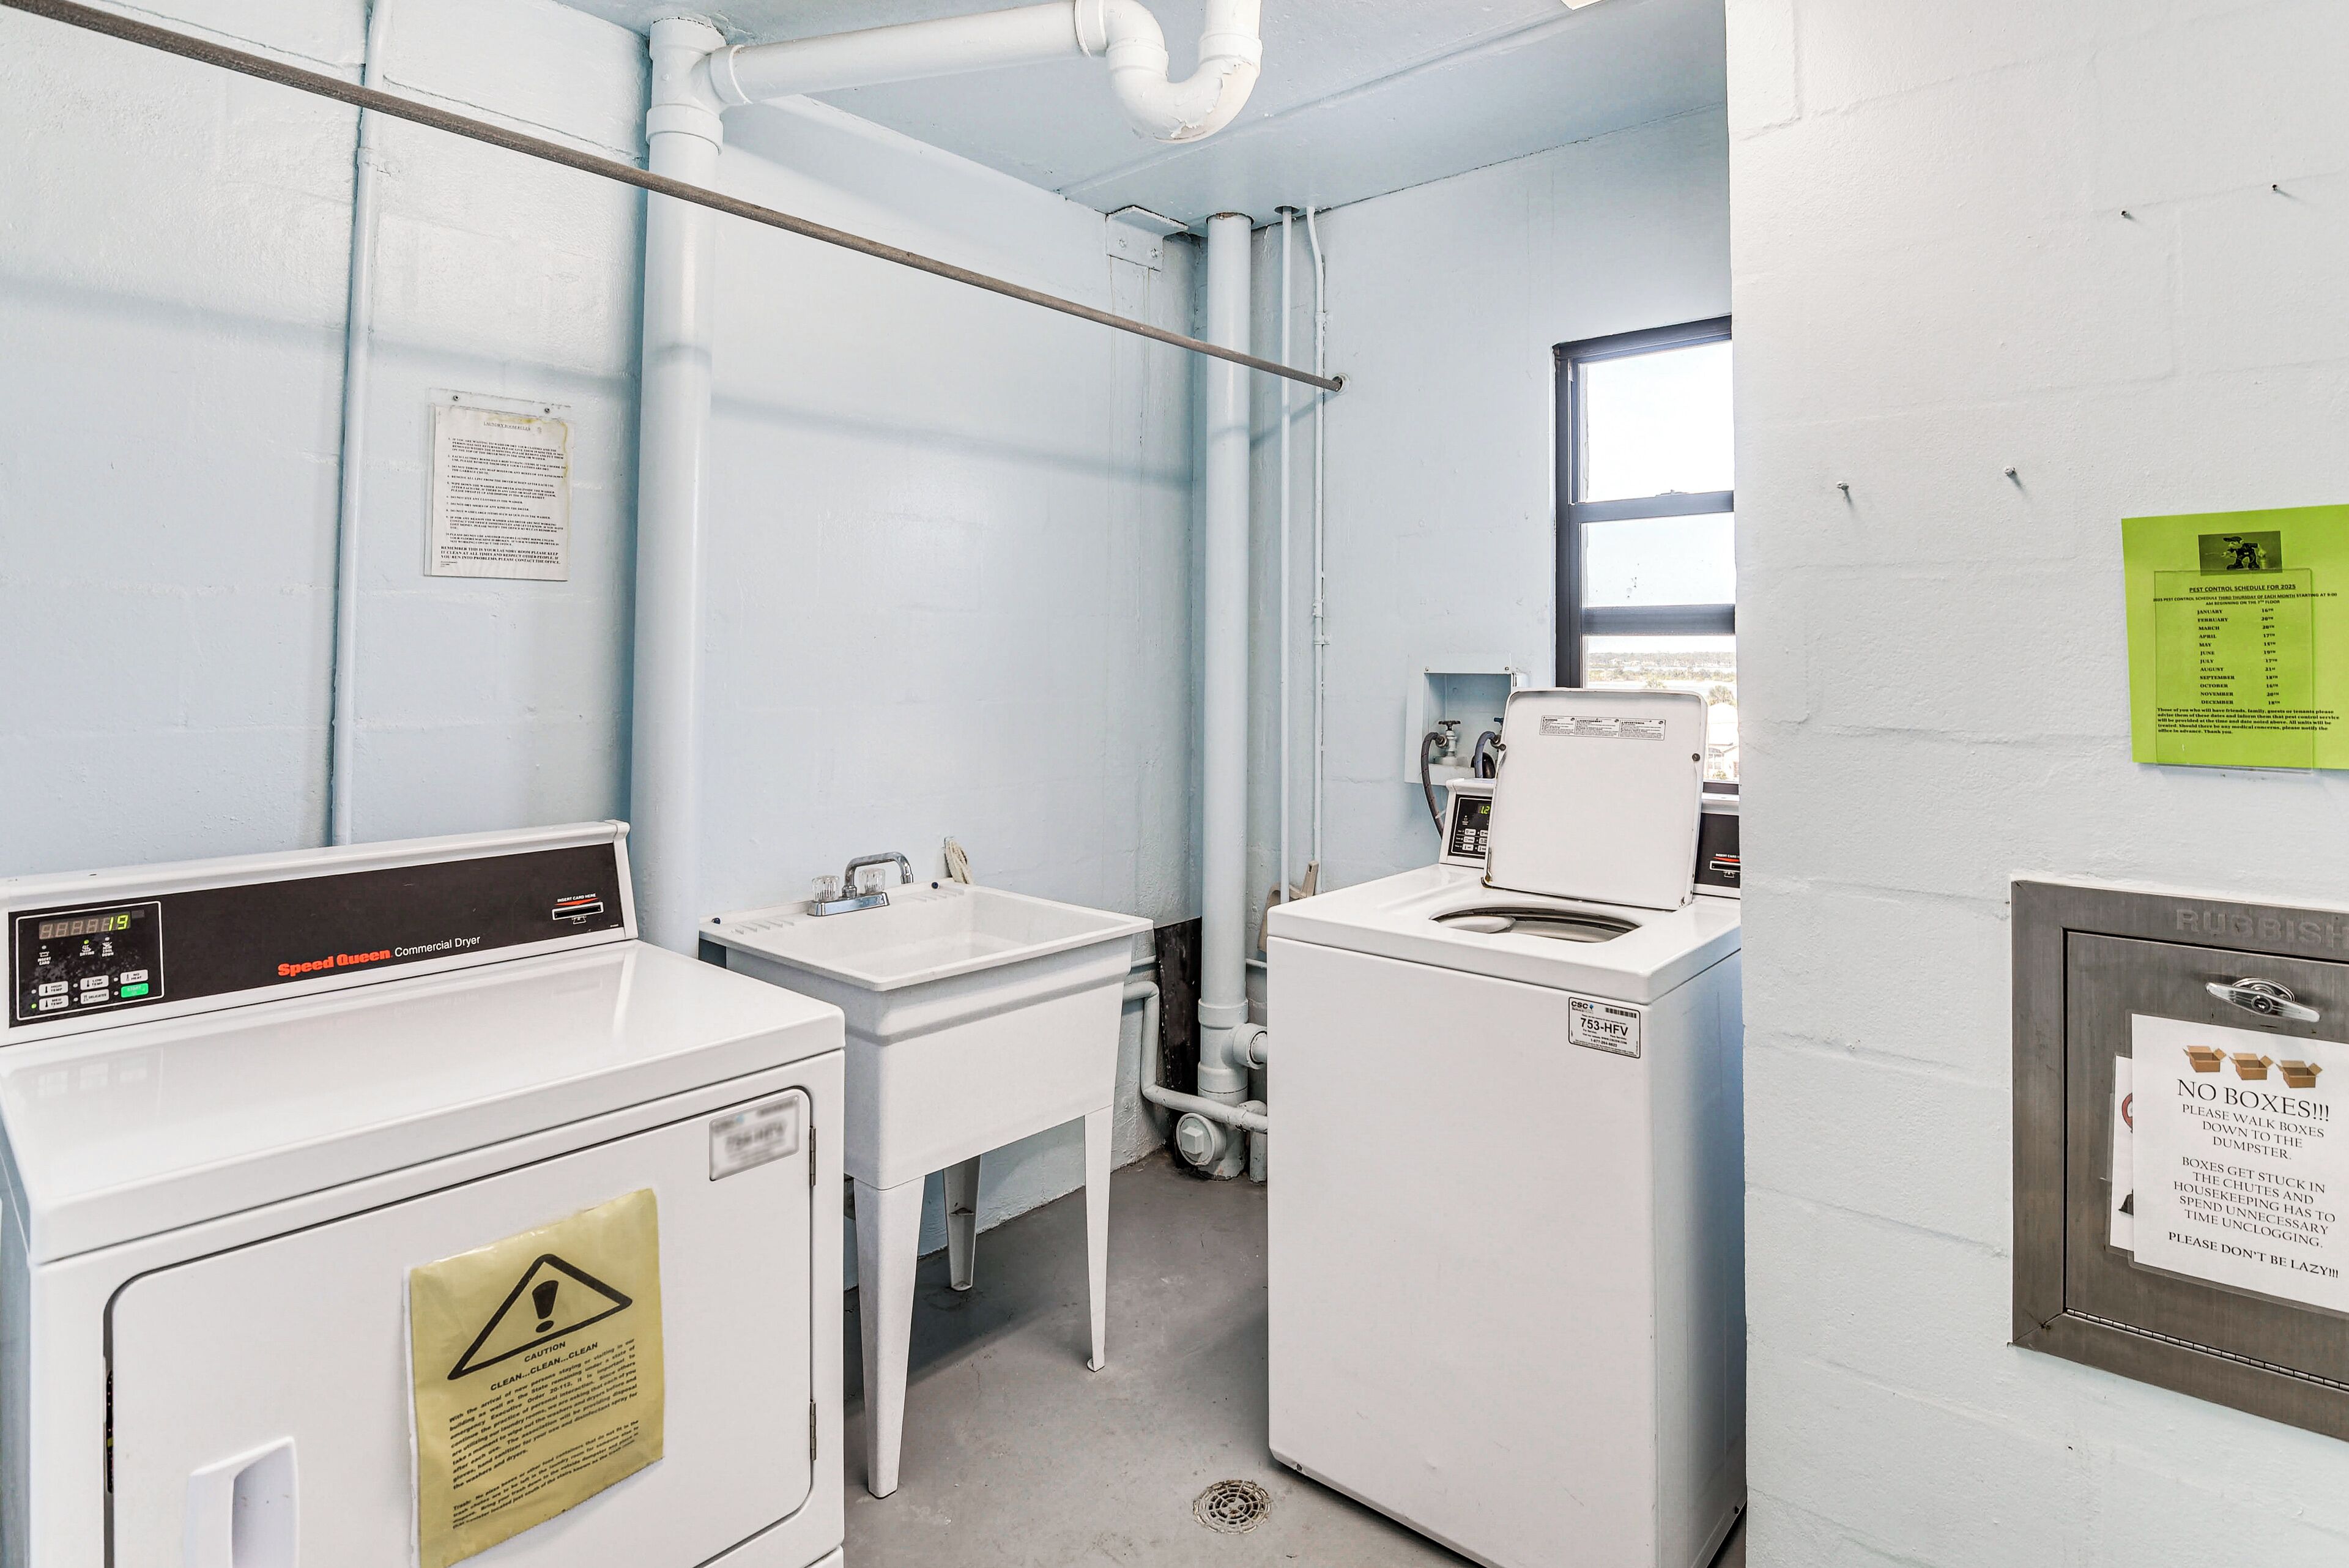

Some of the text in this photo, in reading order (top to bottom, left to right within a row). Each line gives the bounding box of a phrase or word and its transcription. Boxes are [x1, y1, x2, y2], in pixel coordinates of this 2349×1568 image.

[2176, 909, 2349, 950] RUBBISH
[278, 935, 481, 978] Speed Queen Commercial Dryer
[1572, 1001, 1589, 1009] CSC
[1581, 1017, 1628, 1036] 753-HFV
[2176, 1079, 2329, 1121] NO BOXES!!!
[2181, 1104, 2323, 1137] PLEASE WALK BOXES
[2203, 1121, 2303, 1148] DOWN TO THE
[2213, 1135, 2292, 1160] DUMPSTER.
[2183, 1157, 2325, 1193] BOXES GET STUCK IN
[2191, 1172, 2314, 1205] THE CHUTES AND
[2173, 1181, 2336, 1223] HOUSEKEEPING HAS TO
[2180, 1195, 2329, 1235] SPEND UNNECESSARY
[2184, 1209, 2324, 1248] TIME UNCLOGGING.
[2168, 1232, 2339, 1279] PLEASE DON'T BE LAZY!!!
[491, 1342, 598, 1391] CLEAN...CLEAN...CLEAN
[524, 1342, 566, 1362] CAUTION
[449, 1412, 464, 1422] With
[466, 1406, 477, 1414] the
[481, 1395, 502, 1408] arrival
[514, 1384, 527, 1393] new
[531, 1373, 555, 1386] persons
[558, 1362, 581, 1376] staying
[593, 1348, 614, 1360] visiting
[449, 1416, 475, 1431] building
[489, 1402, 503, 1412] well
[531, 1383, 548, 1394] State
[551, 1369, 582, 1386] remaining
[585, 1361, 602, 1372] under
[612, 1350, 626, 1359] state
[450, 1420, 486, 1440] emergency
[491, 1402, 522, 1420] Executive
[527, 1392, 544, 1403] Order
[597, 1358, 624, 1374] important
[451, 1432, 478, 1448] continue
[480, 1425, 491, 1433] the
[493, 1411, 520, 1427] practice
[530, 1395, 557, 1410] personal
[559, 1380, 594, 1398] interaction.
[599, 1370, 615, 1380] Since
[617, 1361, 636, 1372] others
